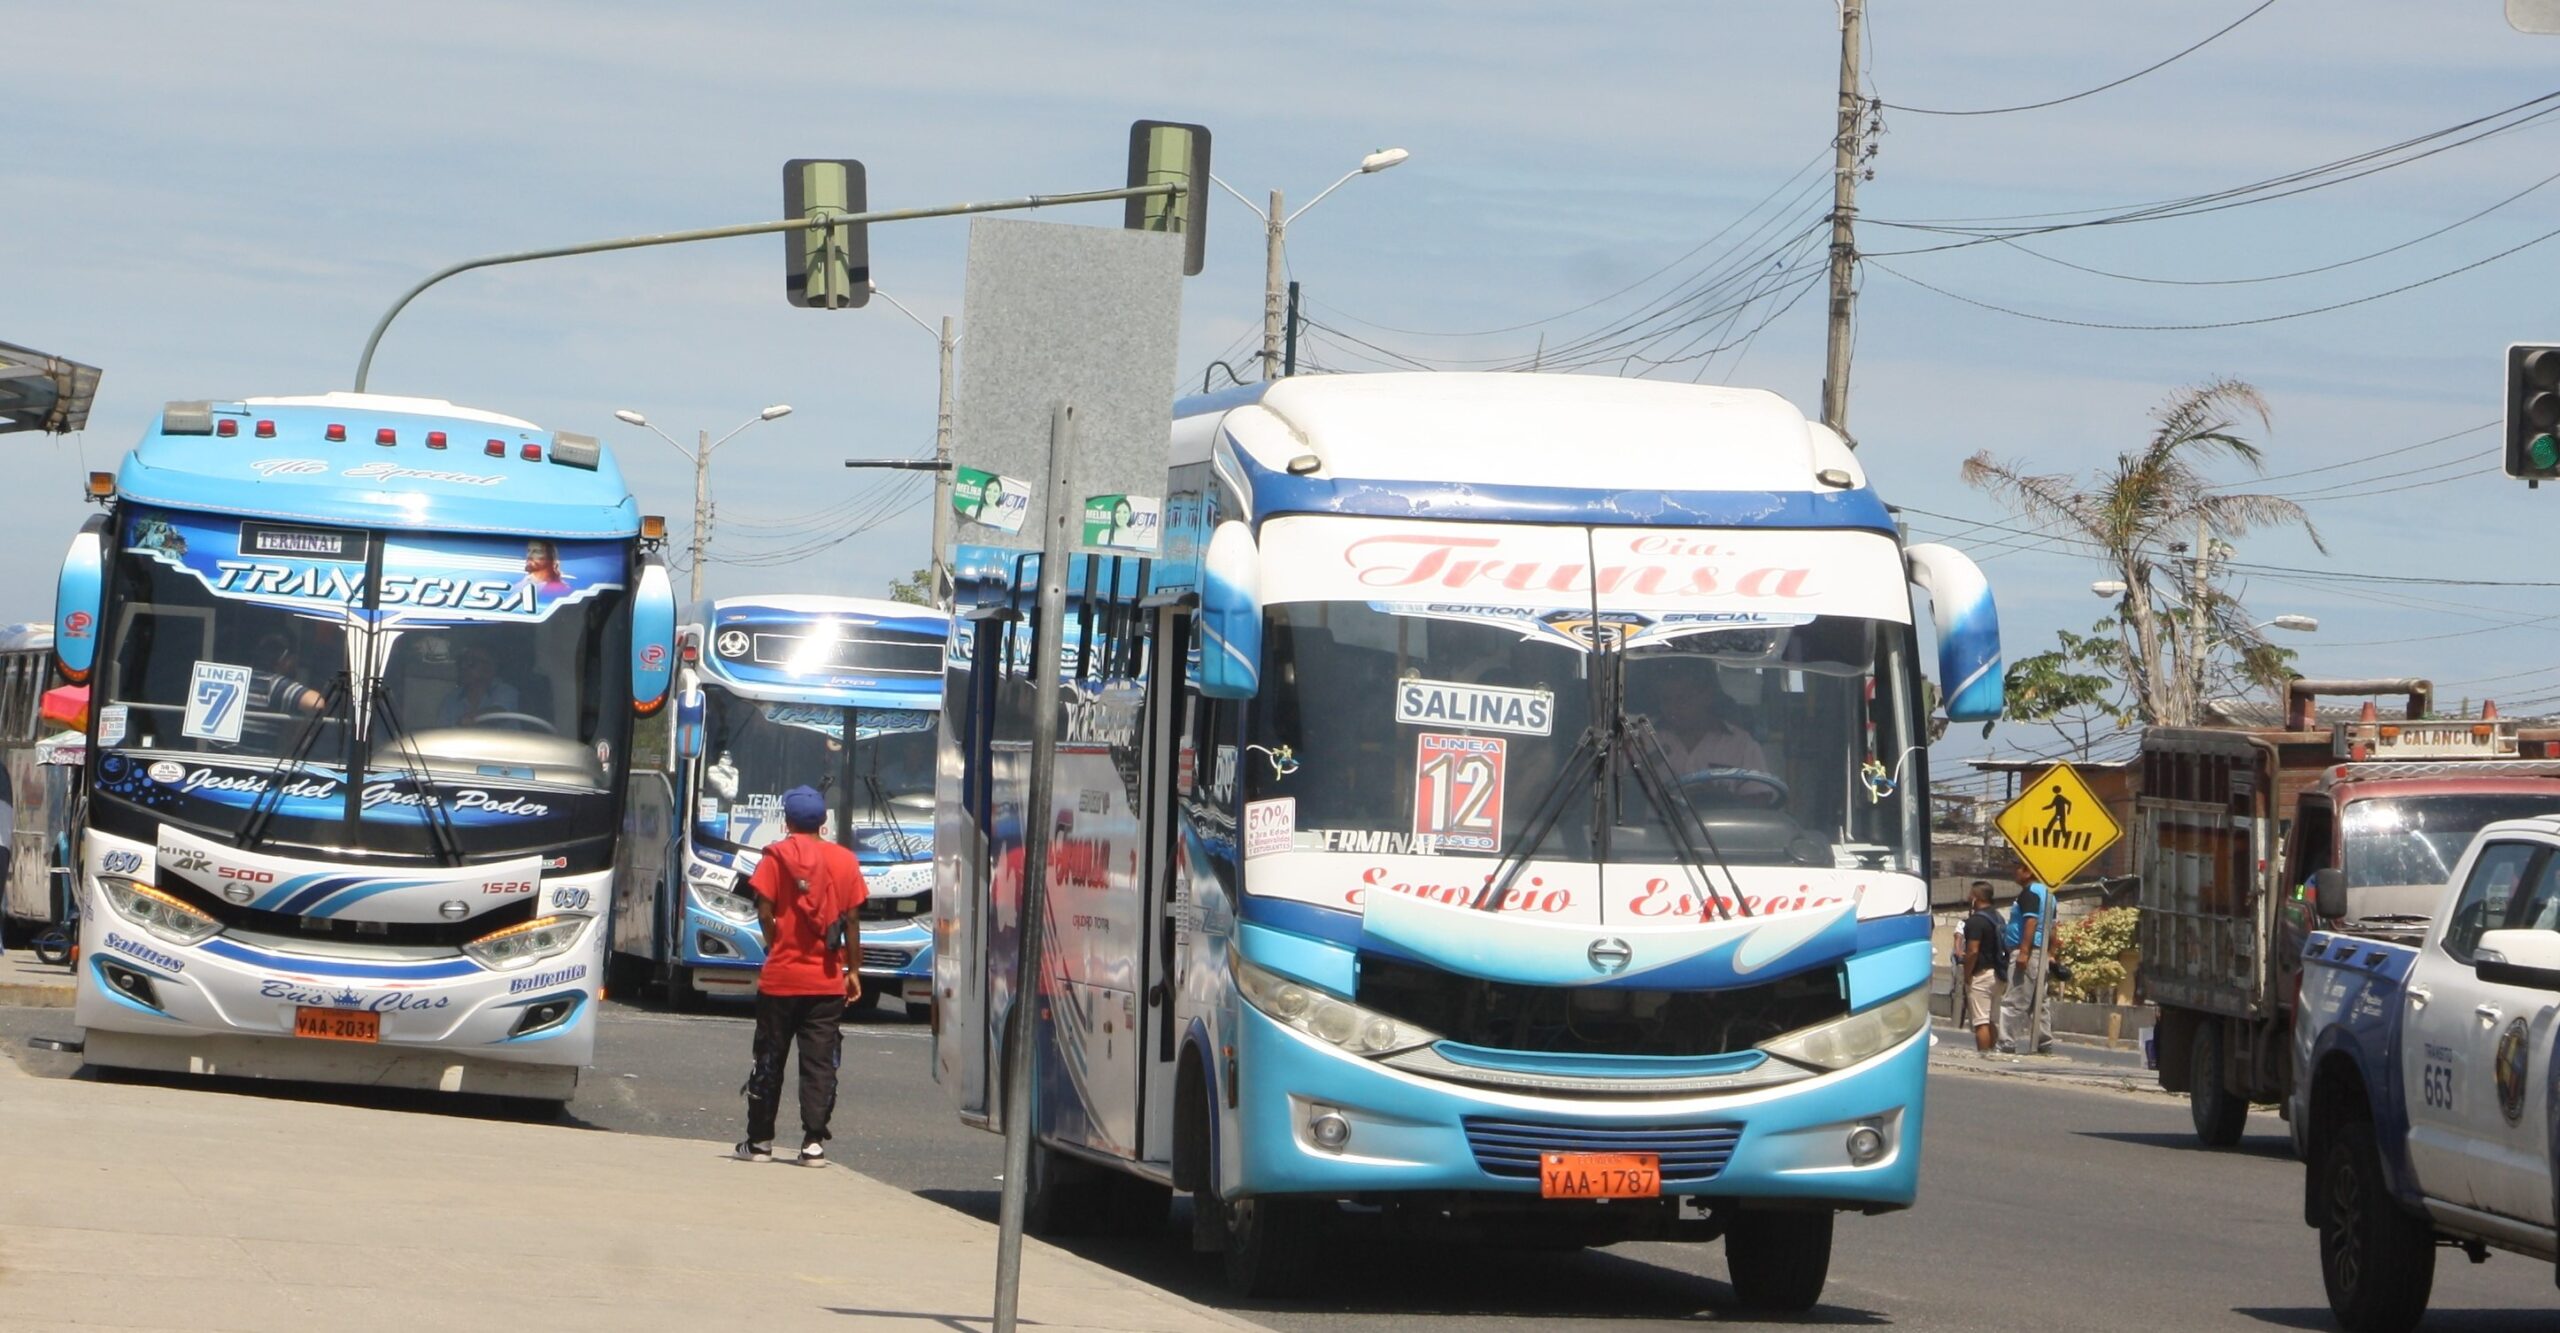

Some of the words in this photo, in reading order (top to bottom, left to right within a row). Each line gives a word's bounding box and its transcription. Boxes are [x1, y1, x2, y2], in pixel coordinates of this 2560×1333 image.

[342, 462, 507, 485] Special
[1132, 511, 1157, 528] VOTA
[259, 532, 340, 551] TERMINAL
[1344, 534, 1823, 598] Trunsa
[217, 560, 541, 614] TRANSCISA
[1426, 603, 1535, 617] EDITION
[1661, 612, 1768, 622] SPECIAL
[196, 667, 245, 682] LINEA
[197, 680, 240, 734] 7
[1403, 688, 1548, 729] SALINAS
[1424, 737, 1501, 753] LINEA
[283, 781, 335, 799] del
[361, 783, 441, 809] Gran
[454, 790, 549, 817] Poder
[1420, 752, 1496, 835] 12
[1249, 803, 1290, 831] 50%
[734, 816, 763, 845] 7
[159, 845, 205, 859] HINO
[174, 858, 214, 873] AK
[218, 866, 275, 883] 500
[706, 872, 729, 883] AK
[481, 881, 532, 894] 1526
[105, 932, 185, 973] Salinas
[260, 979, 326, 1005] Bus
[369, 991, 450, 1013] Clas
[298, 1017, 376, 1039] YAA-2031
[2424, 1063, 2453, 1110] 663
[1547, 1170, 1654, 1195] YAA-1787
